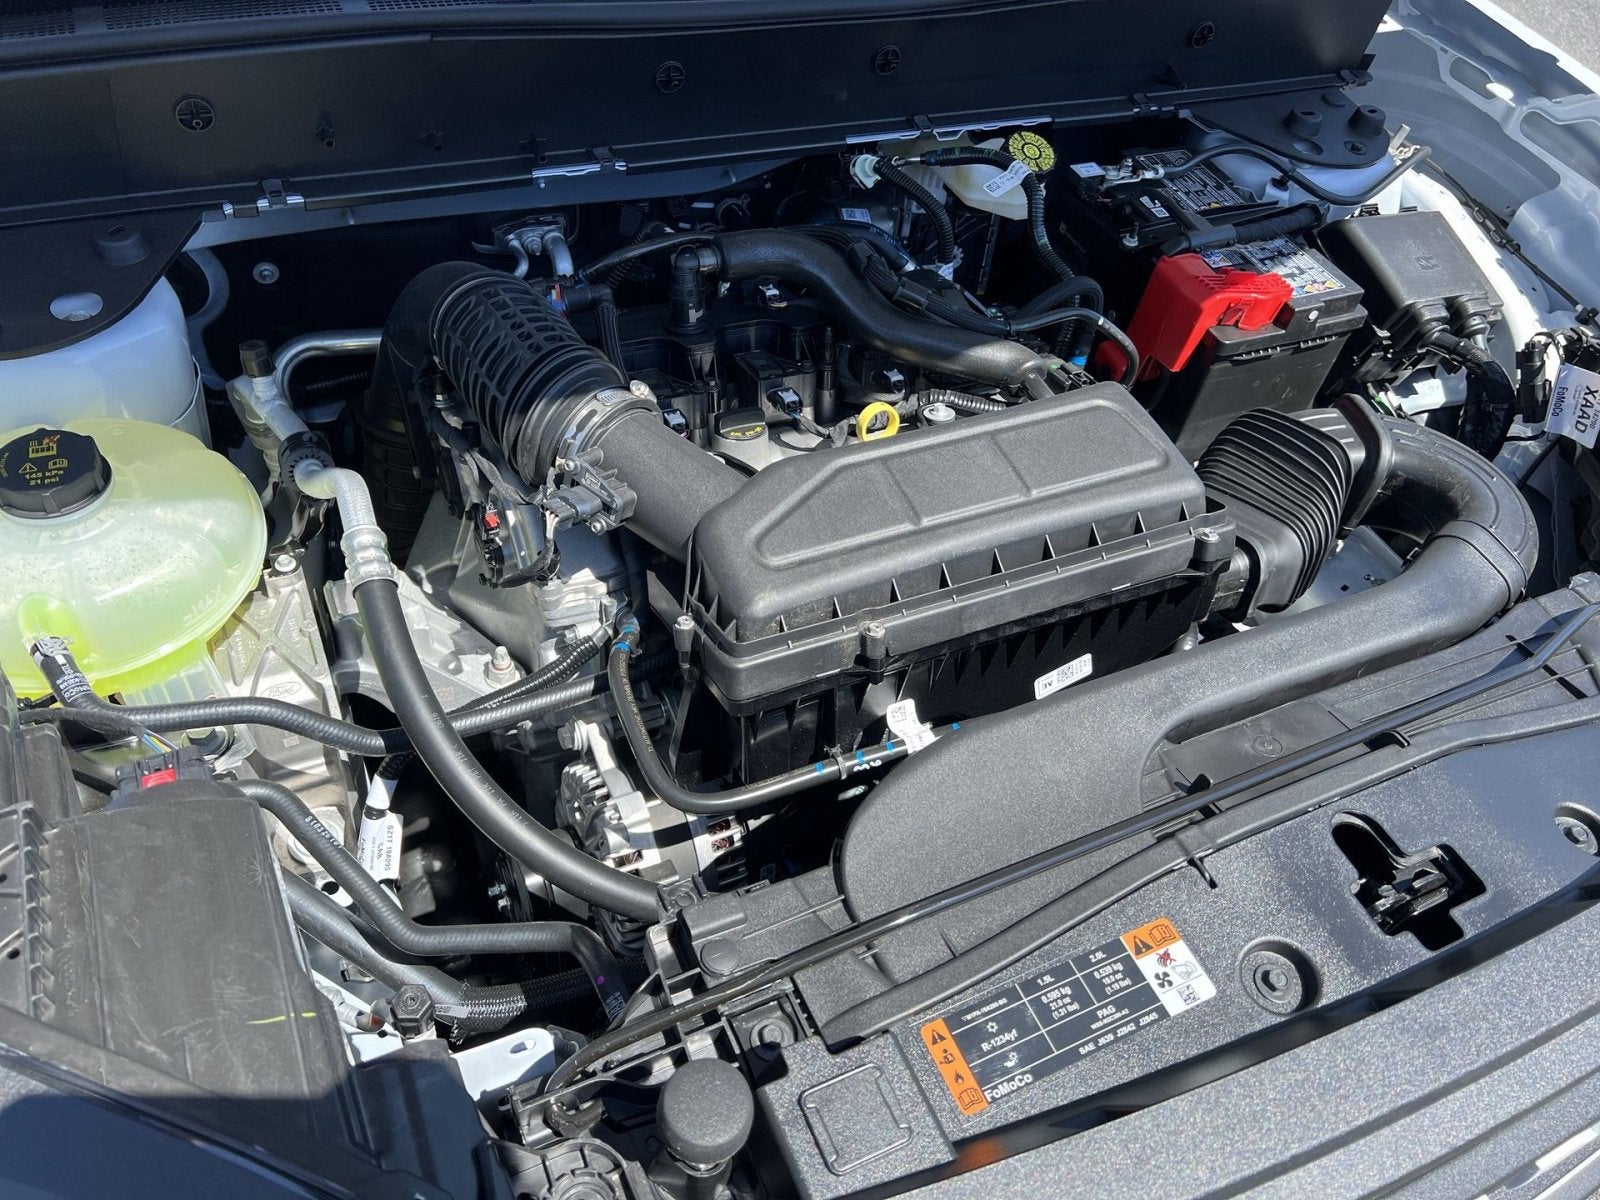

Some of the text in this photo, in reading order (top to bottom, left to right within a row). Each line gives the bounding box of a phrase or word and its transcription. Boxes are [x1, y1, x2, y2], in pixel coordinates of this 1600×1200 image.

[1552, 386, 1568, 417] FoMoCo
[1575, 385, 1599, 433] XAAD
[24, 469, 64, 480] 145 kPa
[44, 477, 59, 485] psi
[1089, 951, 1106, 963] 2.0L
[1037, 974, 1055, 986] 1.5L
[1097, 1004, 1116, 1019] PAG
[981, 1029, 1018, 1052] R-1234yf
[1079, 1042, 1096, 1055] SAE
[984, 1073, 1033, 1102] FoMoCo
